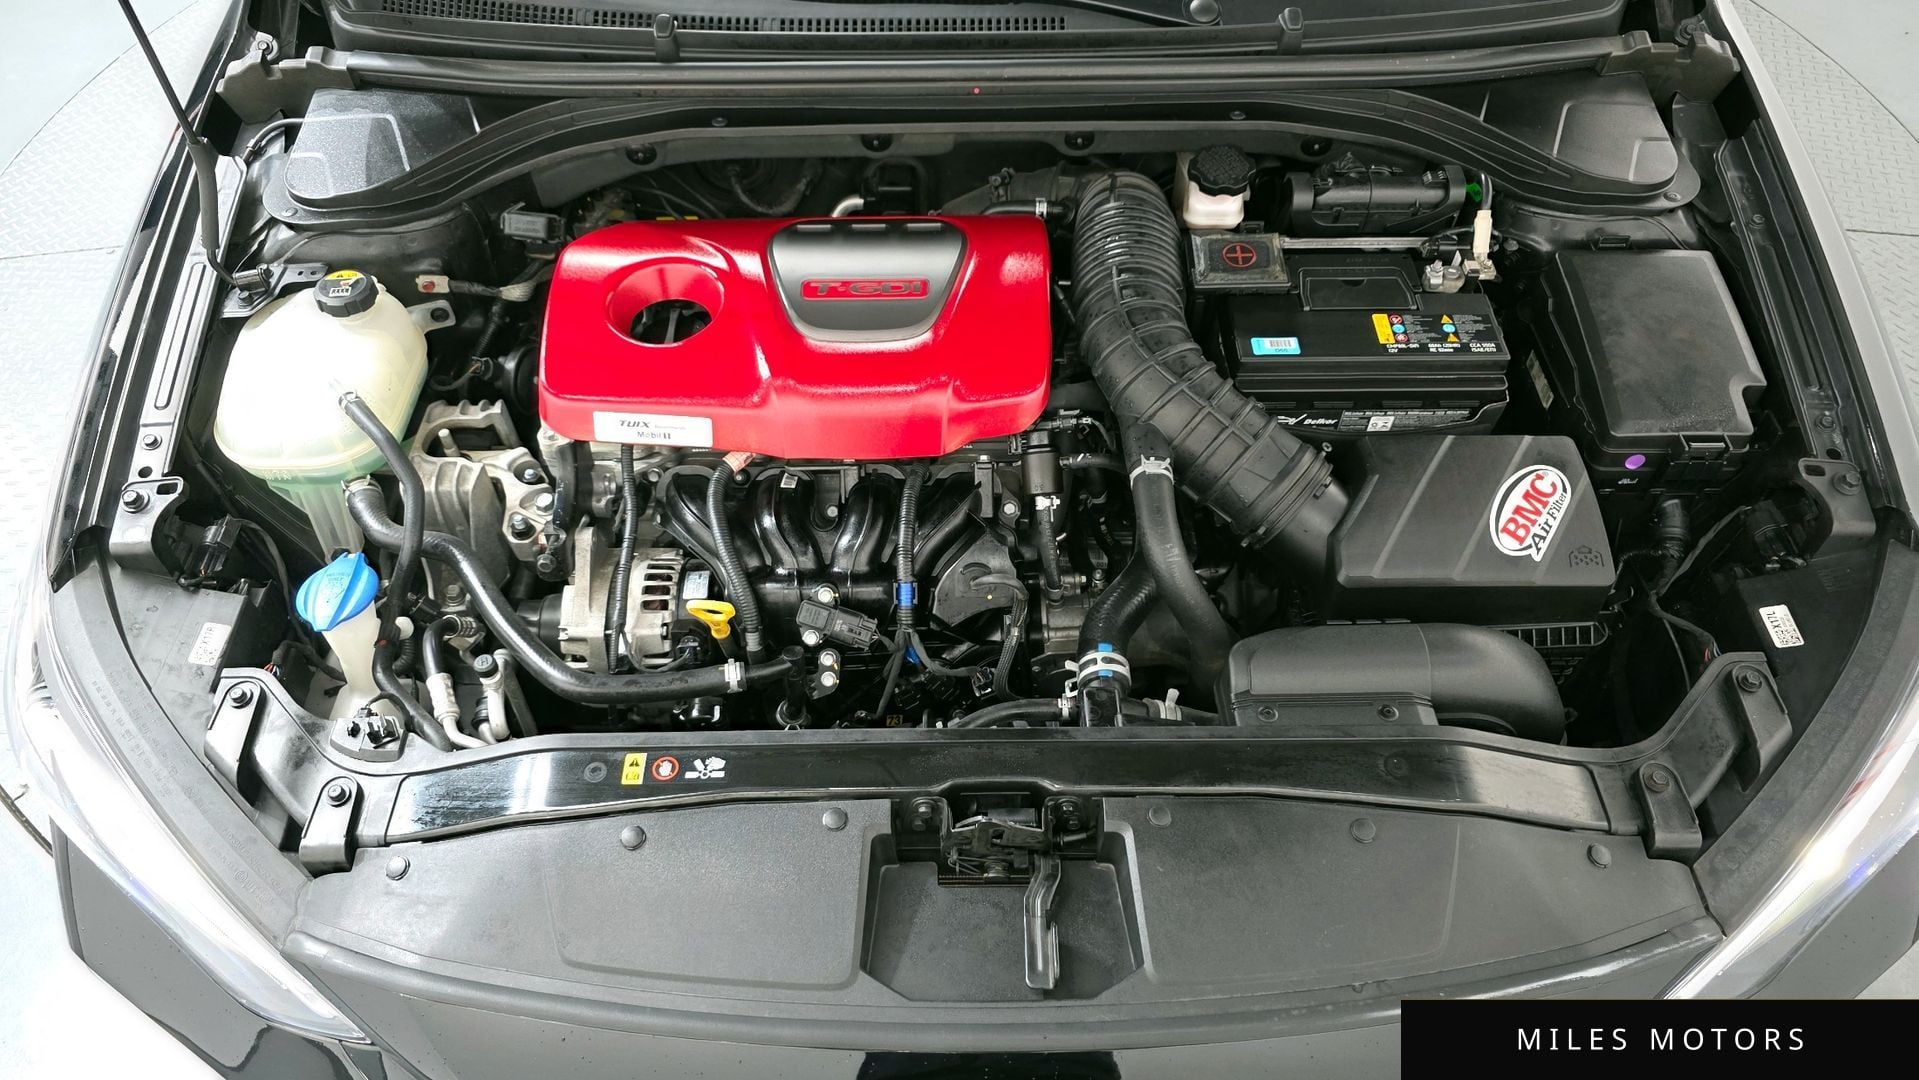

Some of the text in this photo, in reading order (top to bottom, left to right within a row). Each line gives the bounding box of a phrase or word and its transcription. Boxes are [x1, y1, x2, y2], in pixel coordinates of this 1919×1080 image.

[809, 281, 922, 295] T-GDI
[619, 420, 651, 429] TUIX
[1303, 417, 1338, 425] Delkor
[637, 431, 662, 439] Mobil
[1500, 473, 1558, 546] BMC
[1531, 492, 1568, 555] Air Filter
